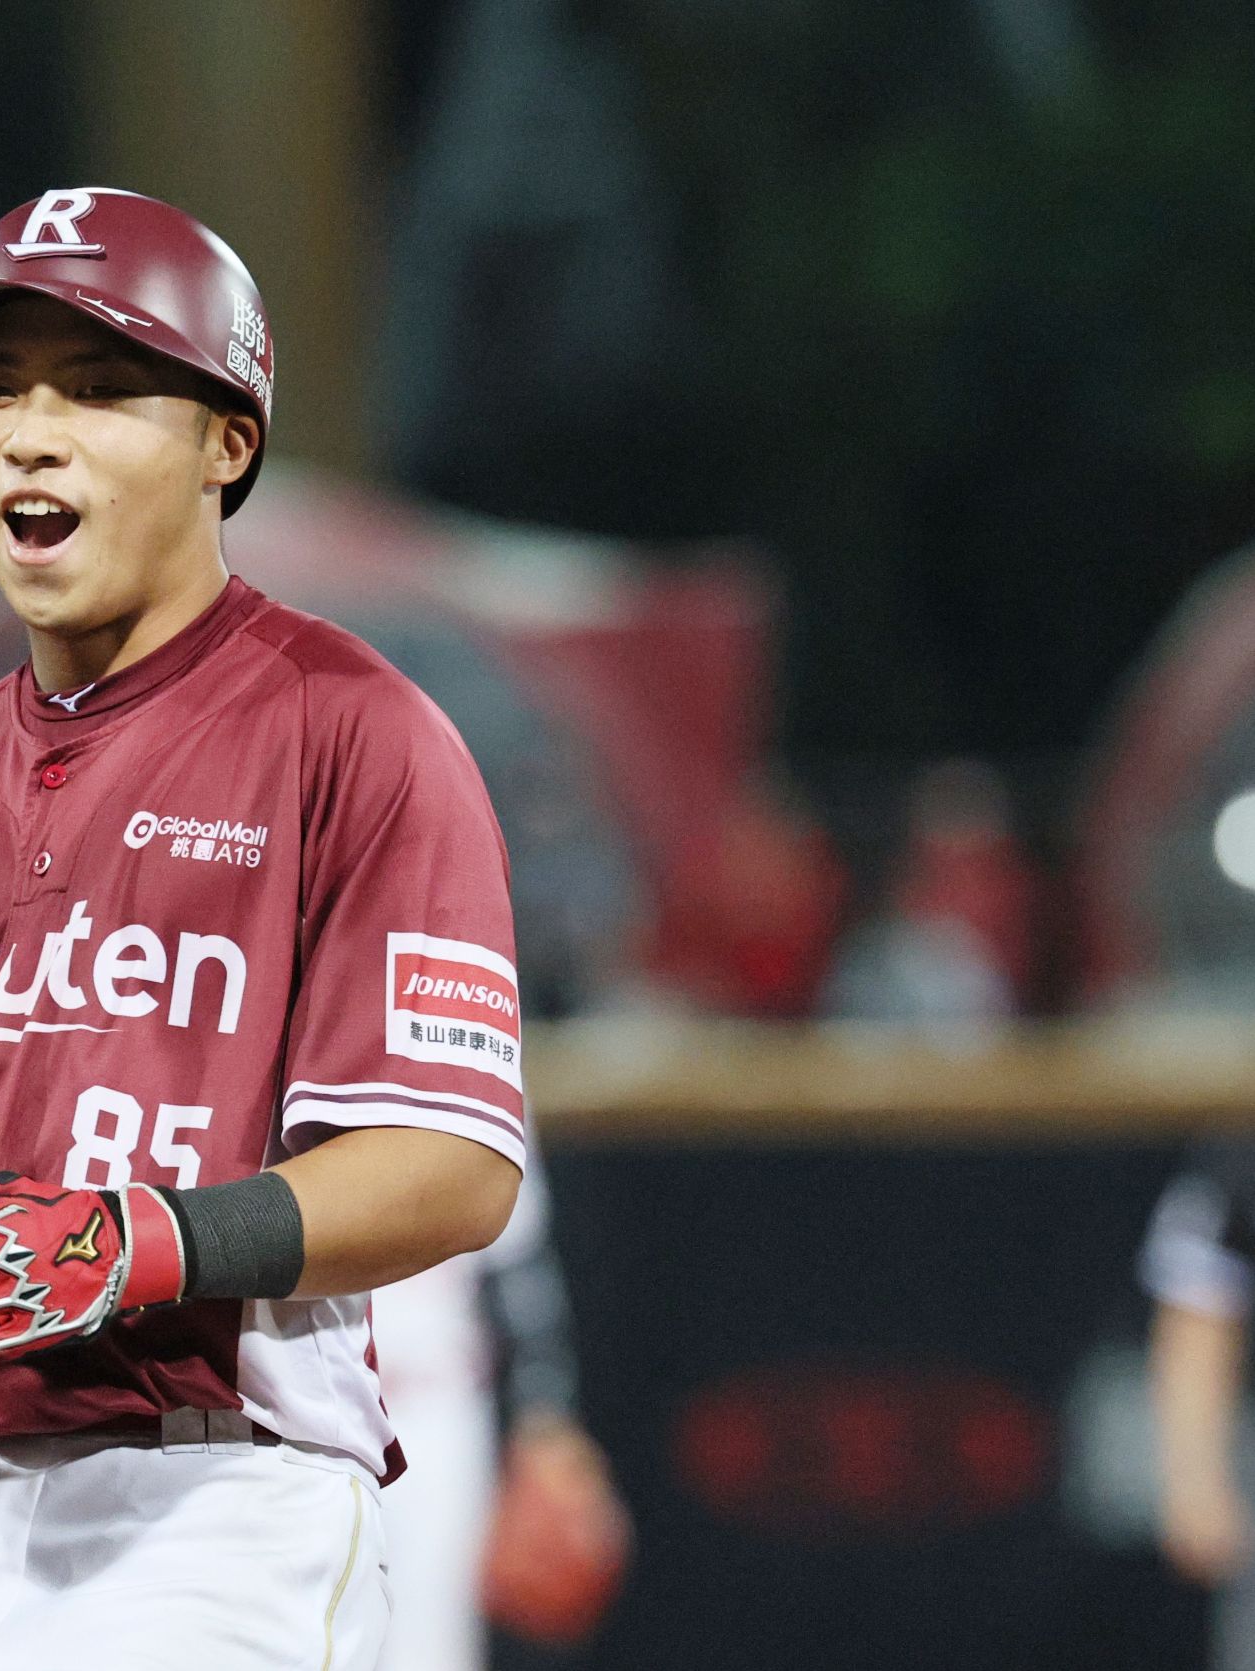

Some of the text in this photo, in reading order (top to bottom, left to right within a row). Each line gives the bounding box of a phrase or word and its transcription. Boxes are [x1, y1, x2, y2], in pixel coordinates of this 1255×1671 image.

[6, 189, 103, 258] R
[402, 972, 516, 1018] JOHNSON
[62, 1085, 213, 1190] 85
